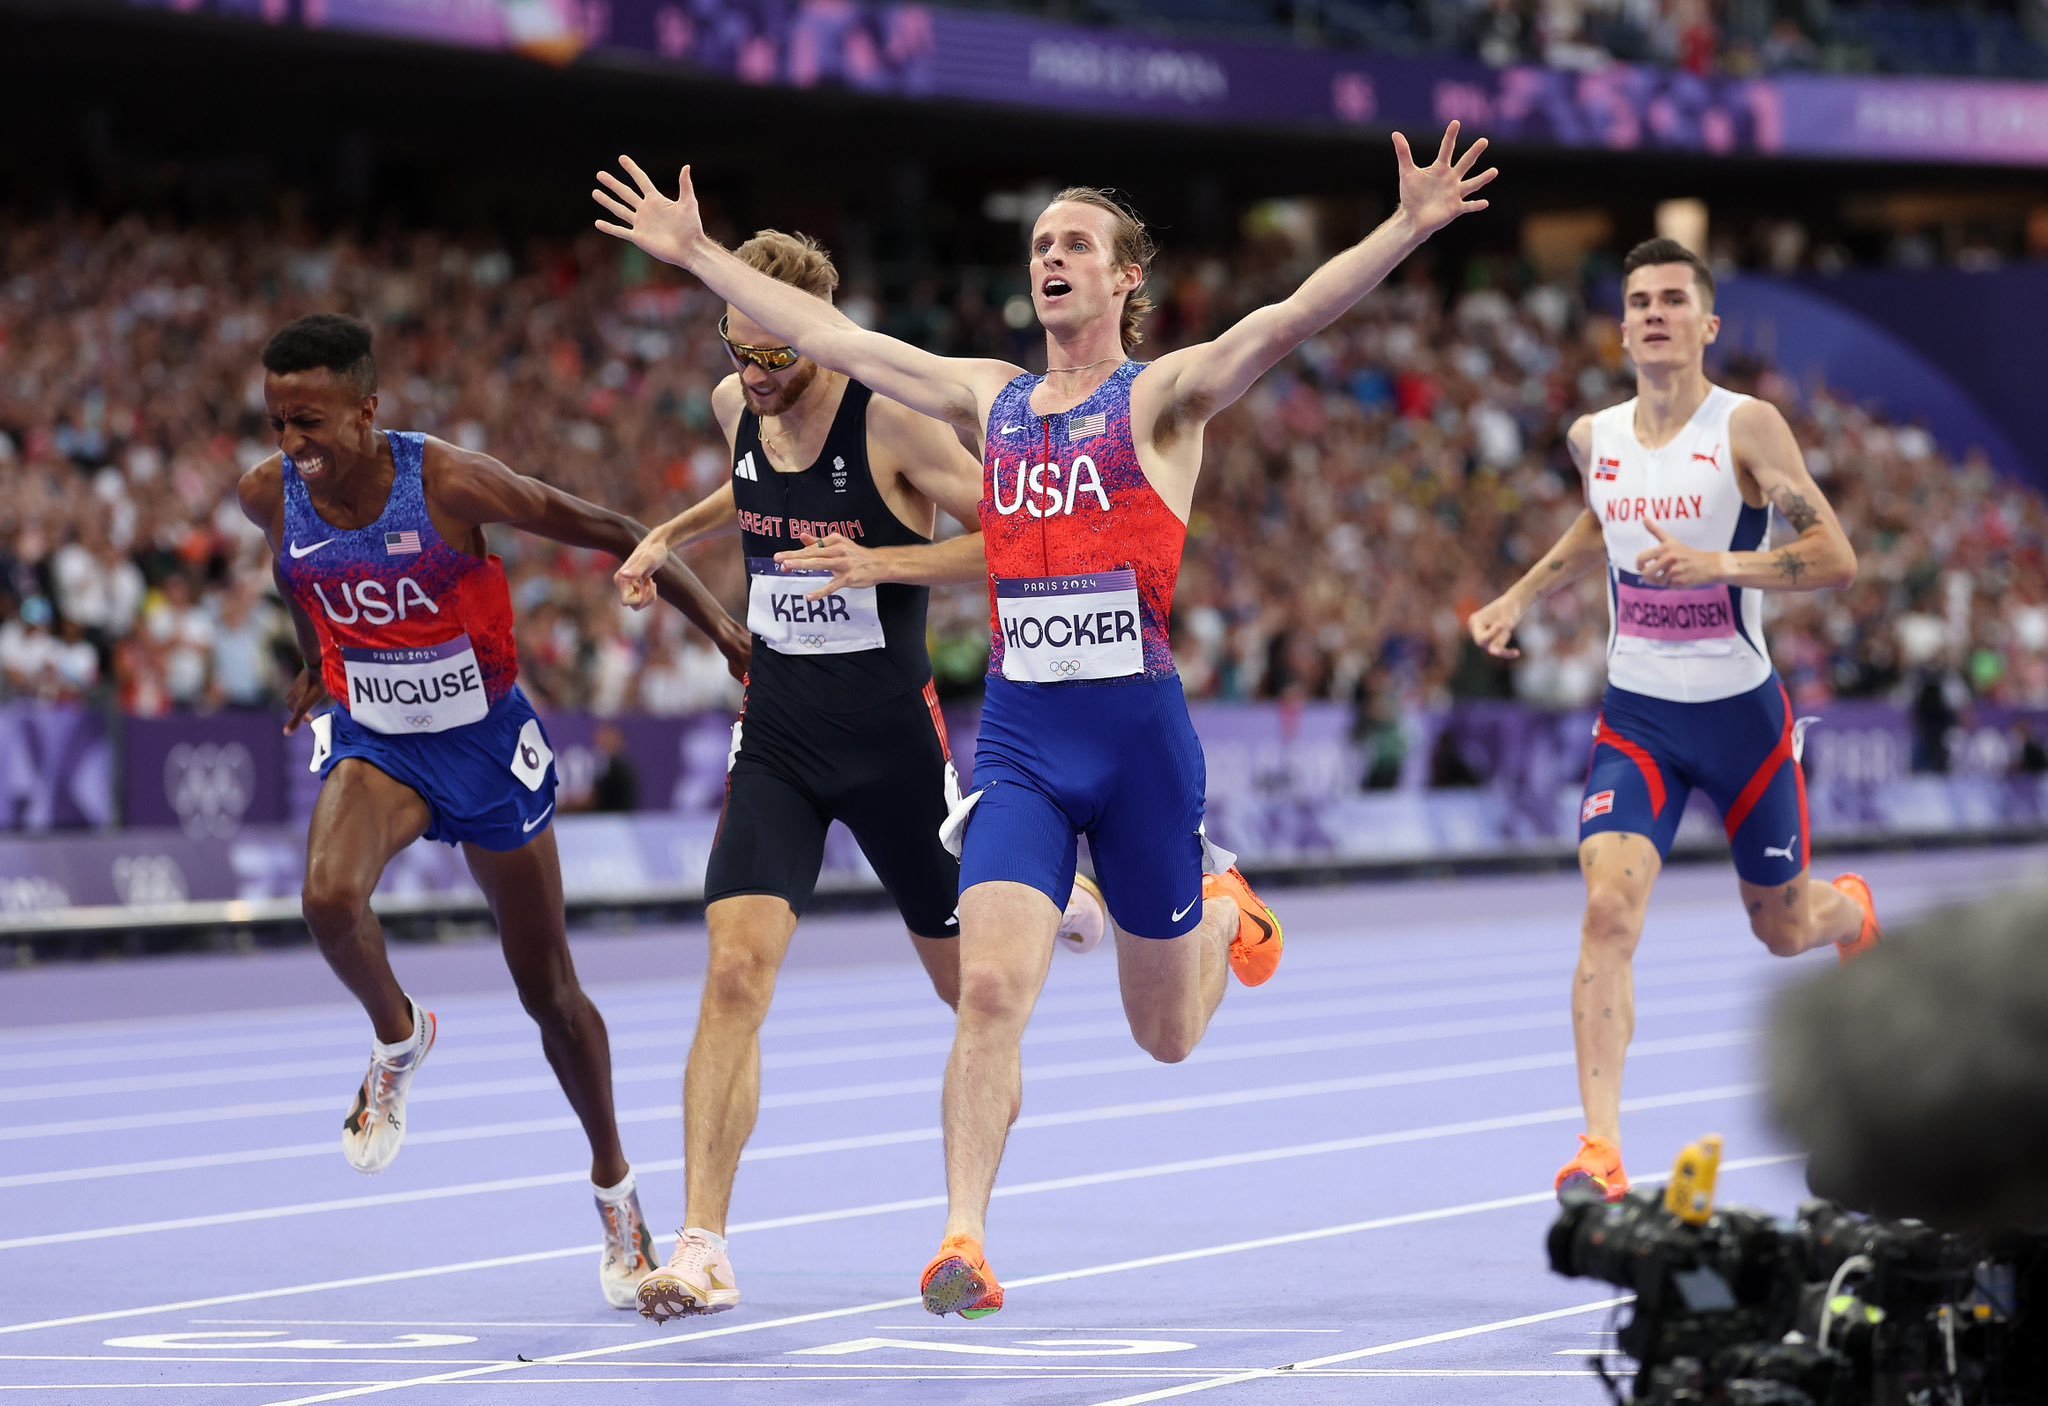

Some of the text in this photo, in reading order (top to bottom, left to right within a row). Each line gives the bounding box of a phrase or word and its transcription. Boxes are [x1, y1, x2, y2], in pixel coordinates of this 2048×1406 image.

[993, 454, 1111, 518] USA
[1605, 495, 1703, 522] NORWAY
[789, 518, 865, 540] BRITAIN
[1023, 579, 1097, 592] PARIS 2024
[313, 577, 440, 625] USA
[771, 594, 851, 623] KERR
[1004, 610, 1137, 649] HOCKER
[372, 650, 438, 662] PARIS 2024
[353, 664, 480, 705] NUGUSE
[520, 741, 540, 770] 6
